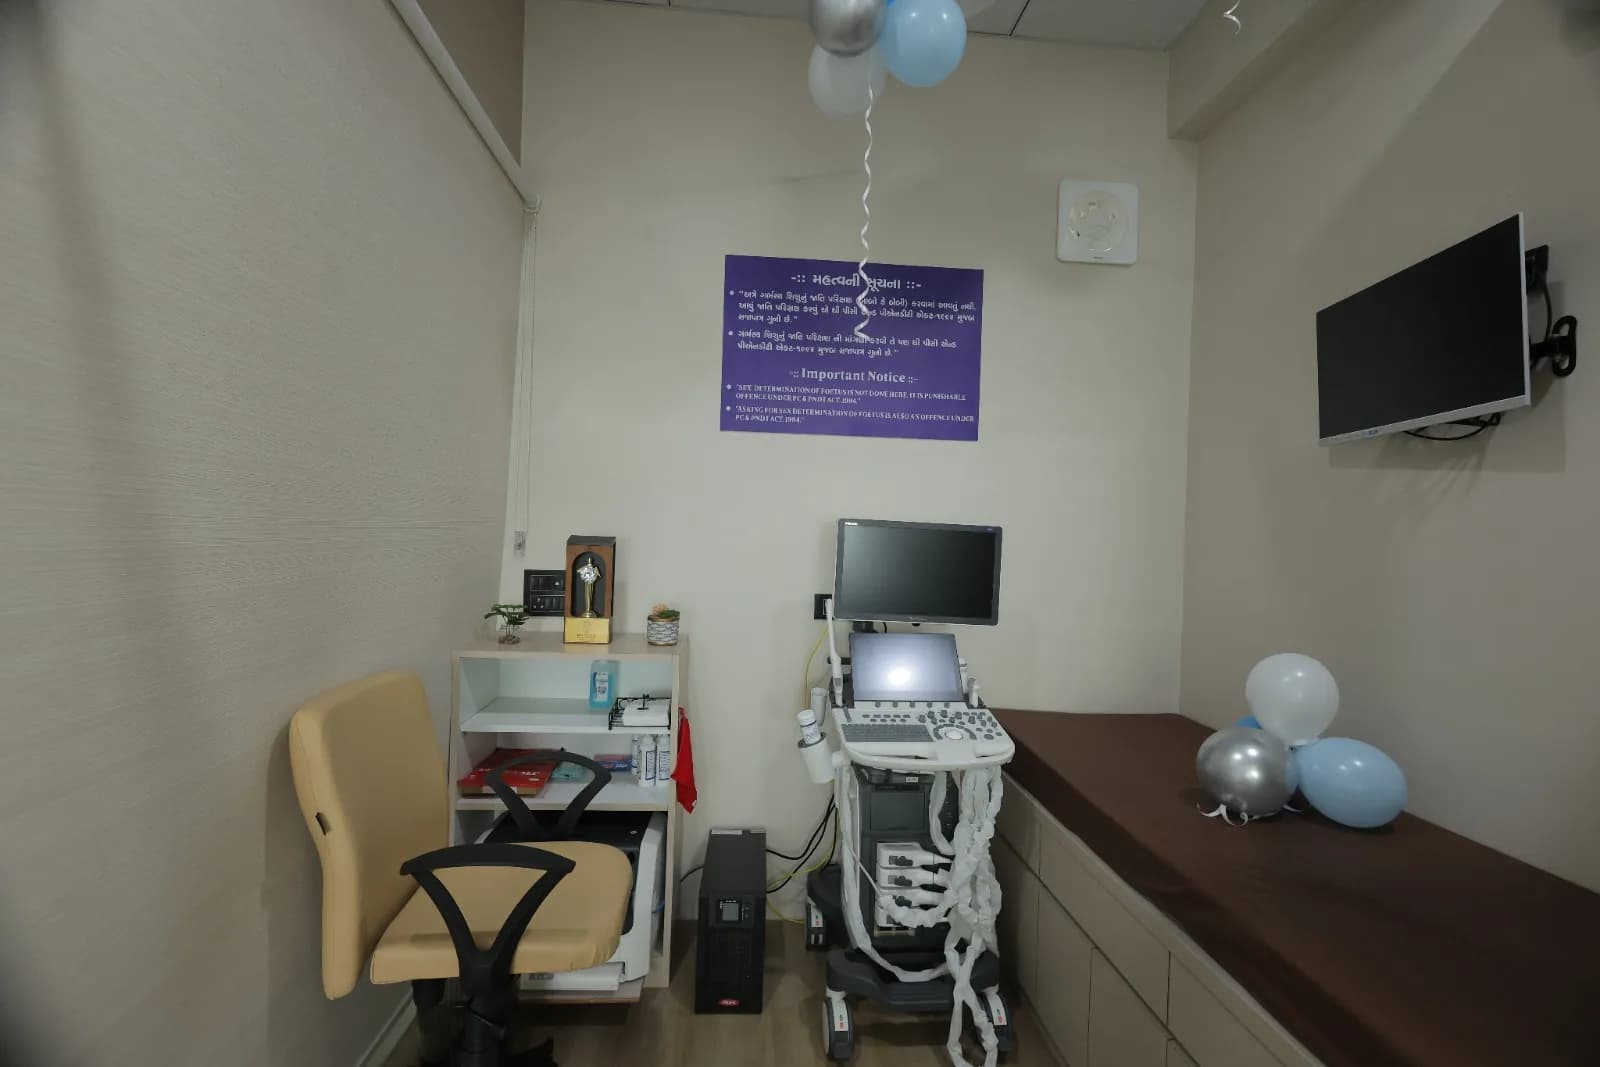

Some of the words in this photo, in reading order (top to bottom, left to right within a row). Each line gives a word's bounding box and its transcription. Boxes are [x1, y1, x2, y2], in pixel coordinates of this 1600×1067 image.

[812, 273, 860, 287] મહત્વની
[867, 278, 901, 292] સૂચના
[801, 368, 865, 382] Important
[868, 370, 906, 383] Notice
[754, 385, 810, 394] DETERMINATION
[821, 388, 846, 396] FOETUS
[869, 390, 888, 398] DONE
[924, 393, 967, 401] PUNISHABLE
[792, 408, 848, 416] DETERMINATION
[891, 412, 910, 420] ALSO
